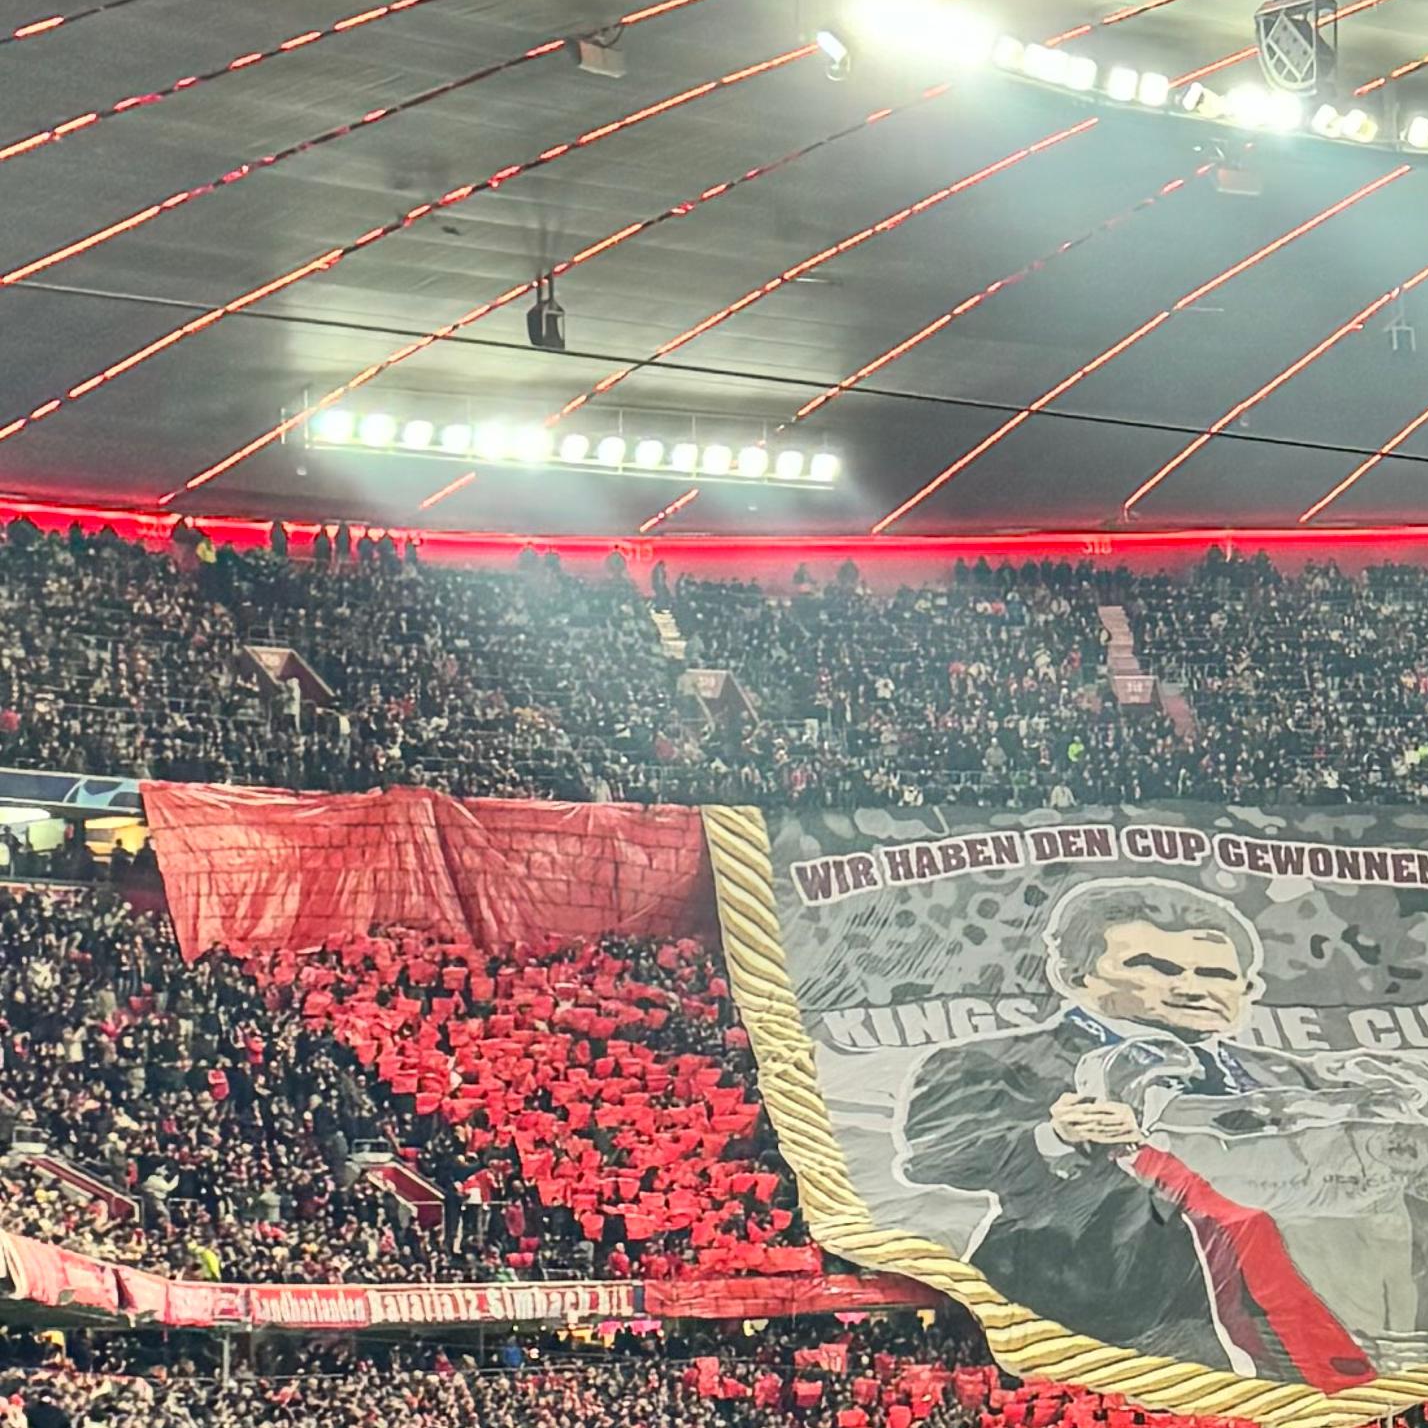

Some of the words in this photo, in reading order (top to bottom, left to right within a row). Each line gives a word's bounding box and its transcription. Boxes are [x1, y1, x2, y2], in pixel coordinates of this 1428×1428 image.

[802, 860, 875, 902] WIR
[885, 834, 1018, 882] HABEN
[1030, 828, 1112, 863] DEN
[1127, 829, 1206, 862] CUP
[822, 998, 1038, 1049] KINGS
